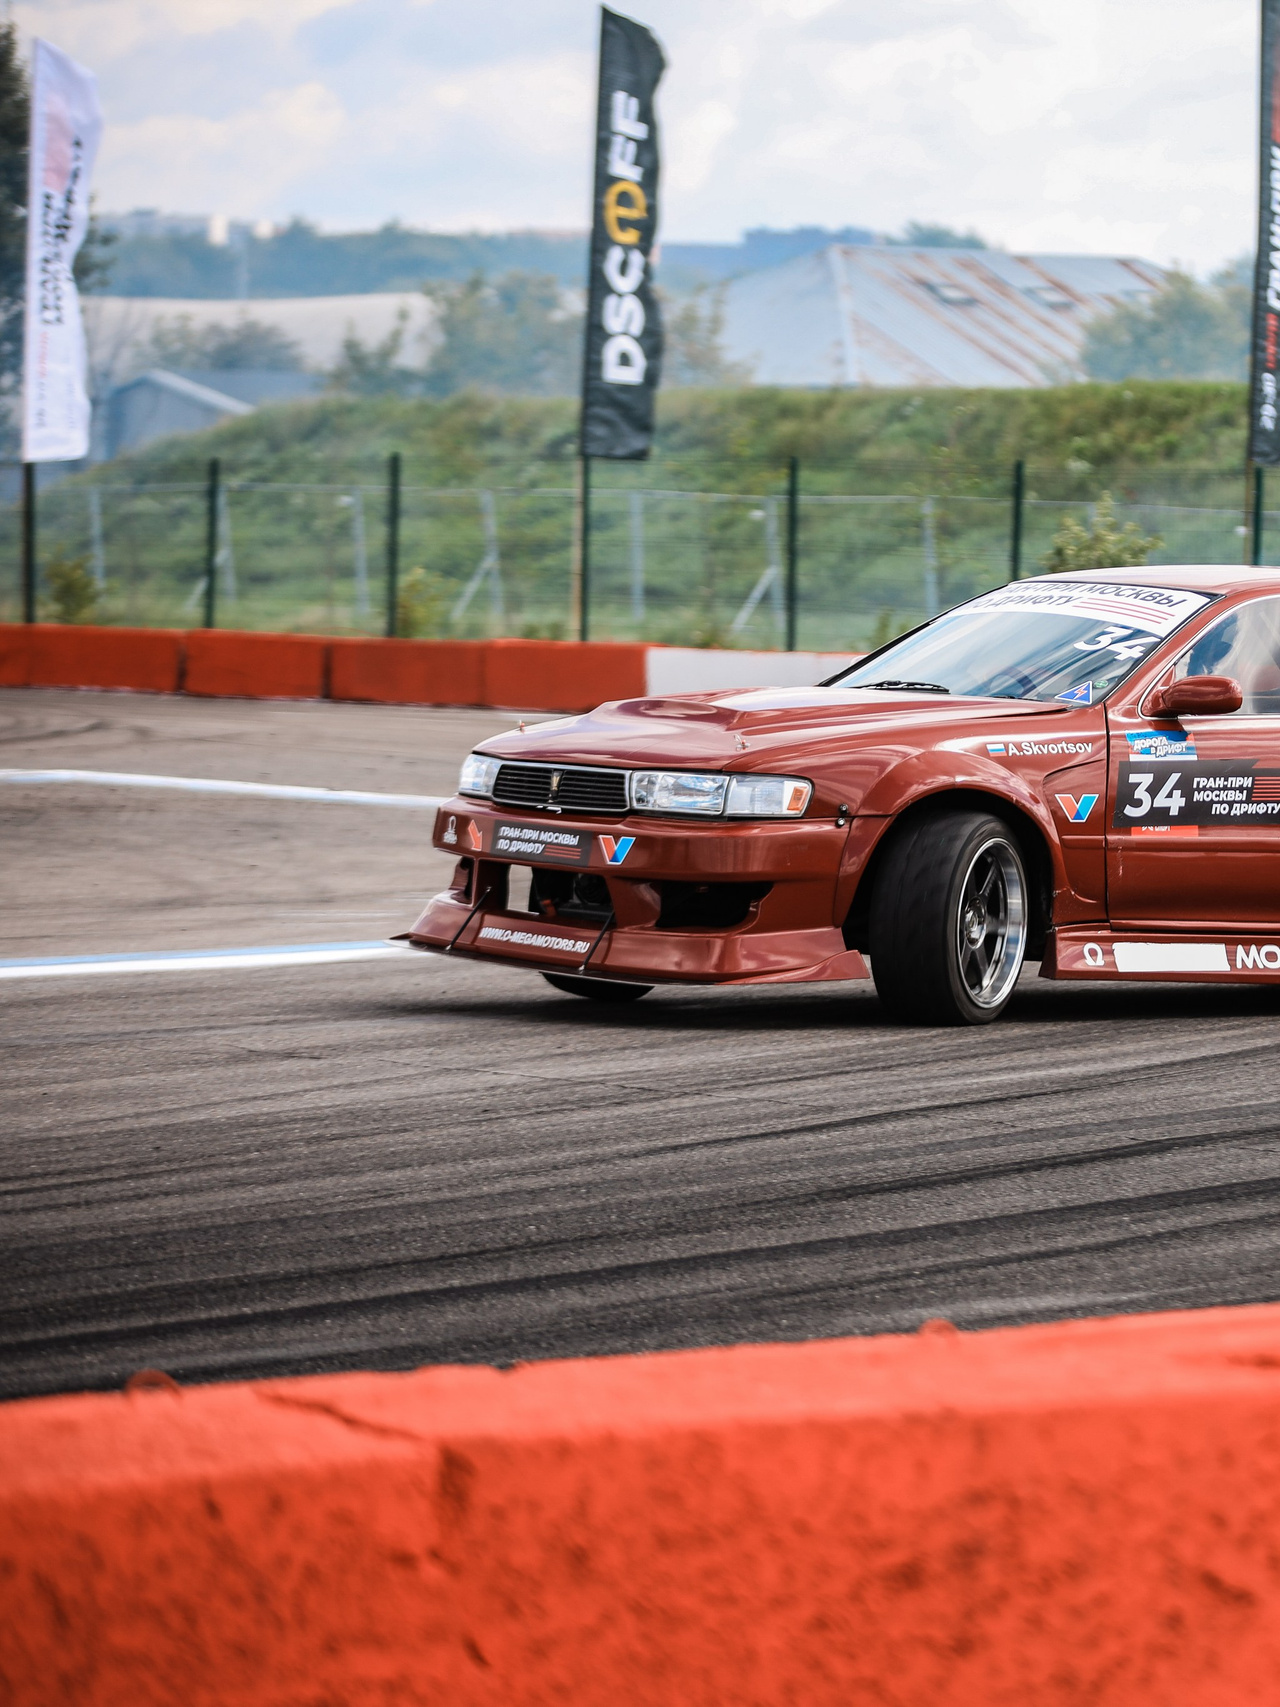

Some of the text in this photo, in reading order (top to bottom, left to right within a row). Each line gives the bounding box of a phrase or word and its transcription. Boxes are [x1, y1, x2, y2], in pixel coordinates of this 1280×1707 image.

[1080, 584, 1187, 608] МОСКВЫ
[1073, 626, 1162, 661] 34
[1008, 741, 1093, 756] A.Skvortsov
[1133, 735, 1168, 751] ДОРОГА
[1155, 742, 1187, 758] ДРИФТ
[1193, 776, 1253, 789] ГРАН-ПРИ
[1123, 772, 1186, 818] 34
[1193, 790, 1247, 802] МОСКВЫ
[1211, 803, 1230, 815] ПО
[499, 826, 580, 846] ГРАН-ПРИ МОСКВЫ
[497, 838, 546, 854] ПО ДРИФТУ
[479, 926, 592, 953] WWW.O-MEGAMOTORS.RU
